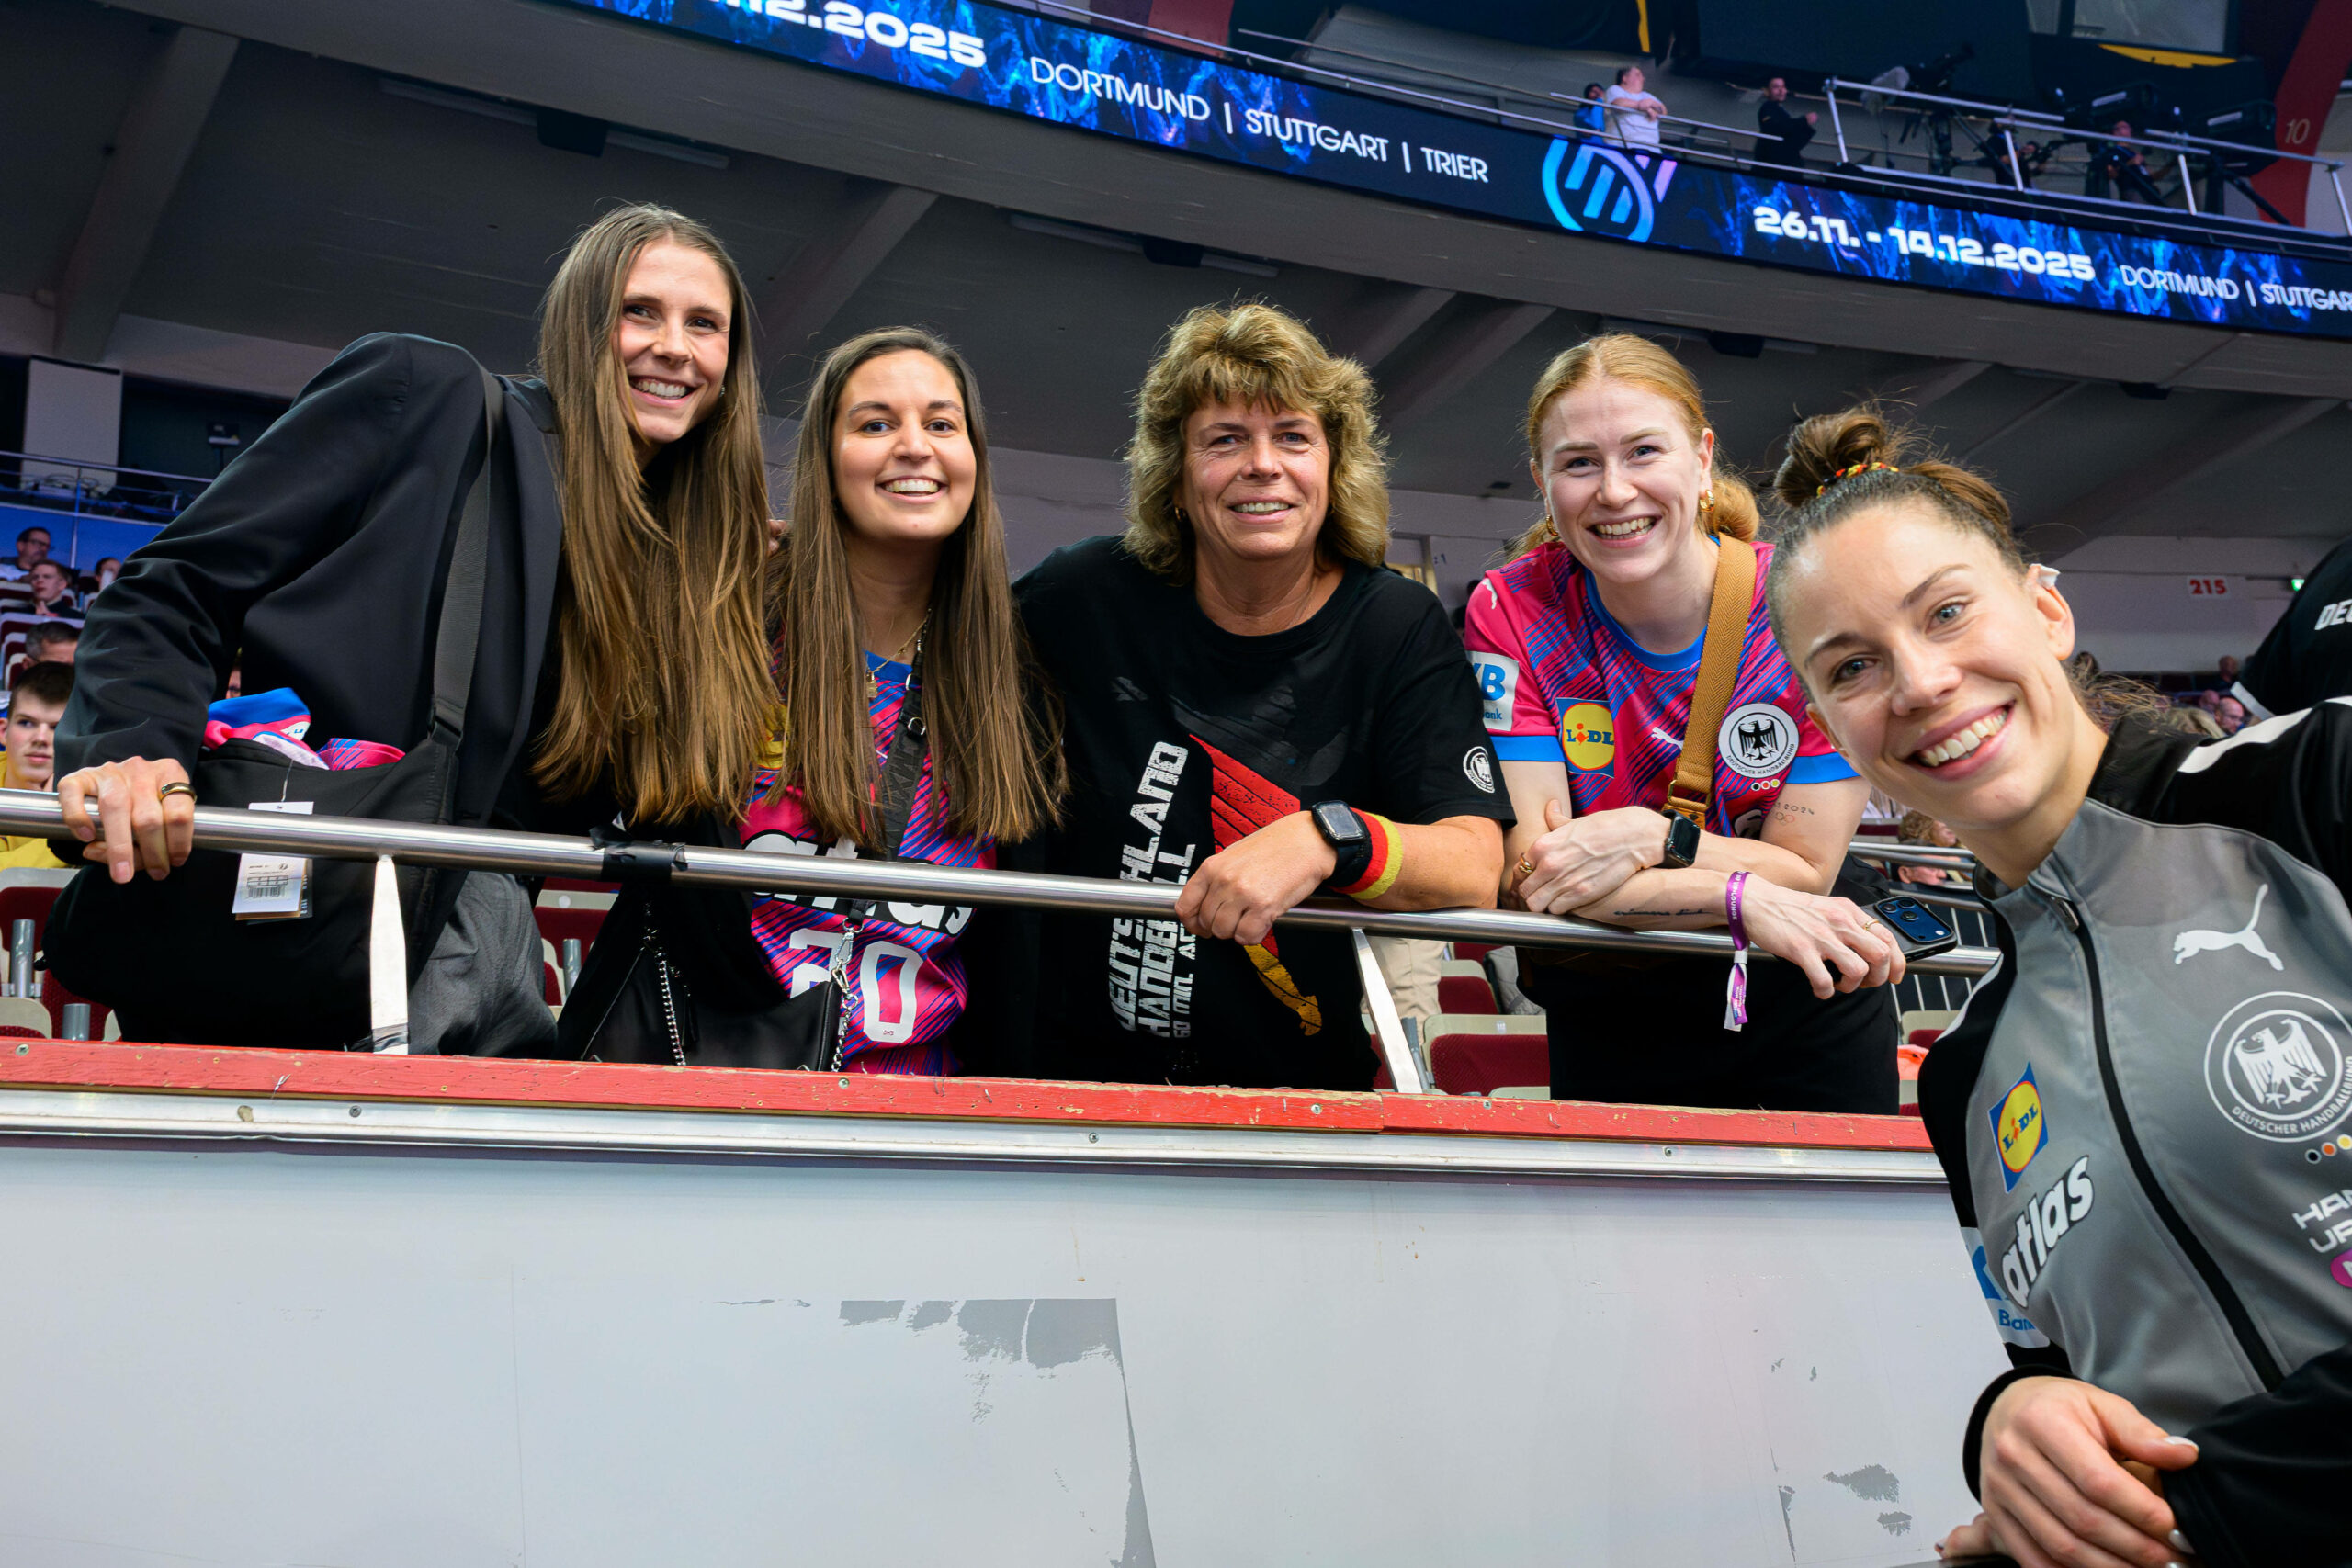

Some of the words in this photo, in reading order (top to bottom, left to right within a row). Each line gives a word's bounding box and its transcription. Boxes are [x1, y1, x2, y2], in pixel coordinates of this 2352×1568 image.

[1031, 58, 1211, 121] DORTMUND
[1246, 110, 1388, 162] STUTTGART
[1421, 146, 1488, 184] TRIER
[2285, 118, 2311, 144] 10
[1754, 206, 1860, 248] 26.11.
[1888, 227, 2096, 282] 14.12.2025
[2119, 265, 2240, 300] DORTMUND
[2260, 283, 2352, 313] STUTTGAR
[2189, 579, 2227, 595] 215
[1757, 743, 1795, 775] HANDBALLBUND
[1109, 741, 1189, 1032] DEUTSHLAND
[2231, 1105, 2299, 1134] DEUTSCHER
[2002, 1155, 2095, 1309] atlas
[1998, 1309, 2037, 1331] Ban
